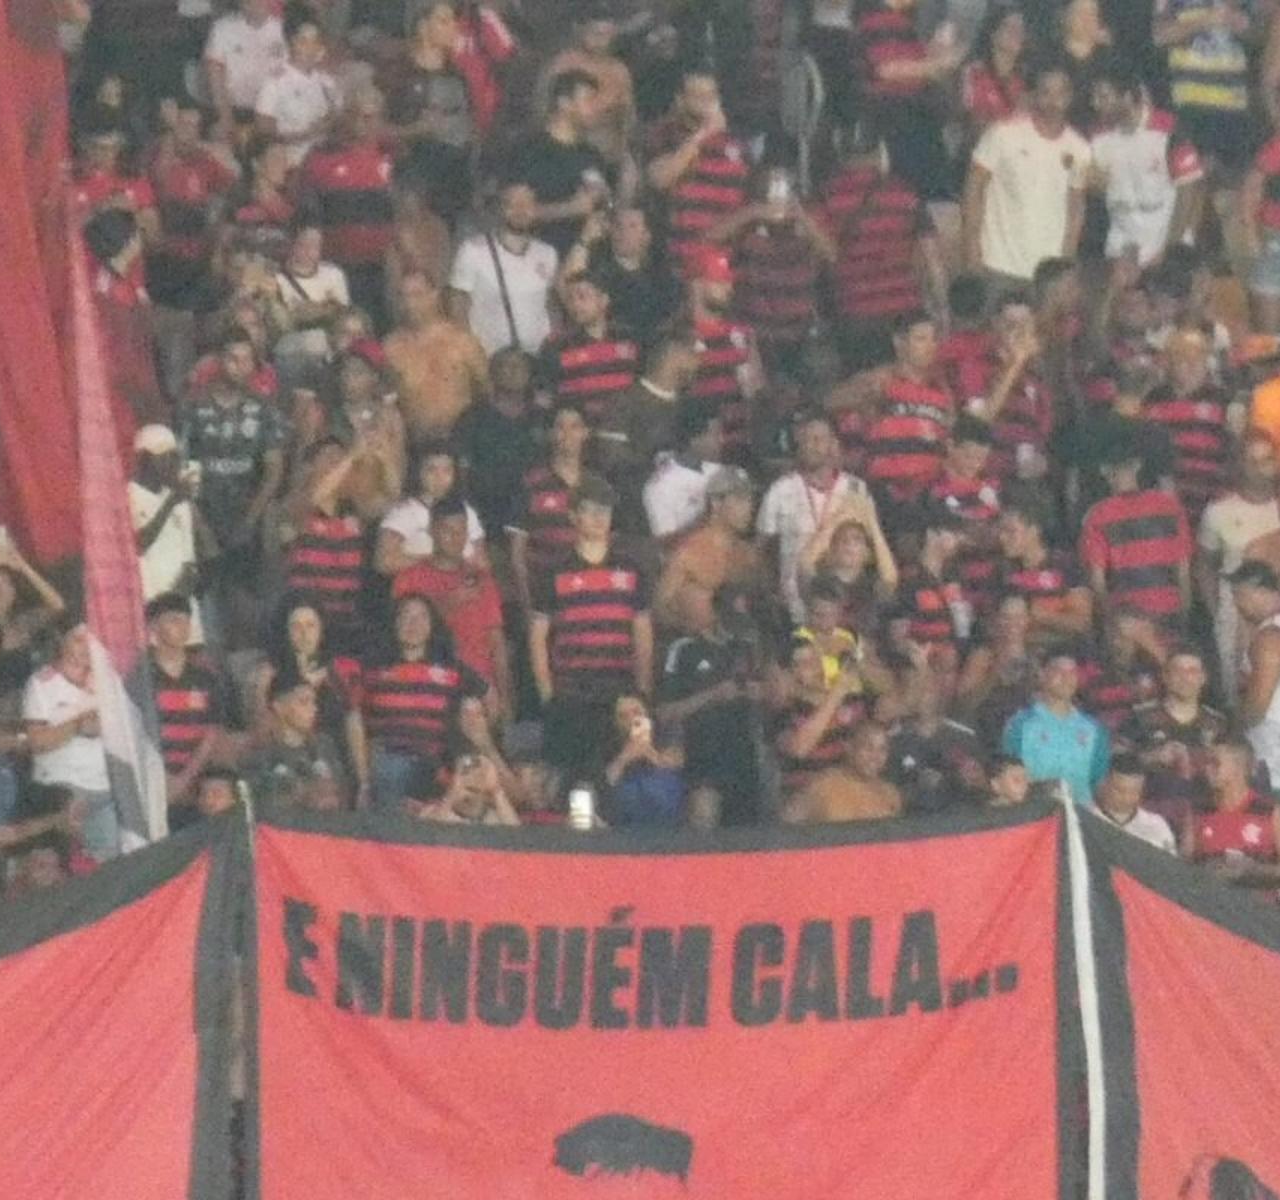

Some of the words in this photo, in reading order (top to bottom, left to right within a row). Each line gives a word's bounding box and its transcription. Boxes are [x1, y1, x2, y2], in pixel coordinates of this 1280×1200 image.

[282, 897, 318, 997] E
[336, 904, 711, 1030] NINGUÉM
[731, 911, 1018, 1027] CALA...
